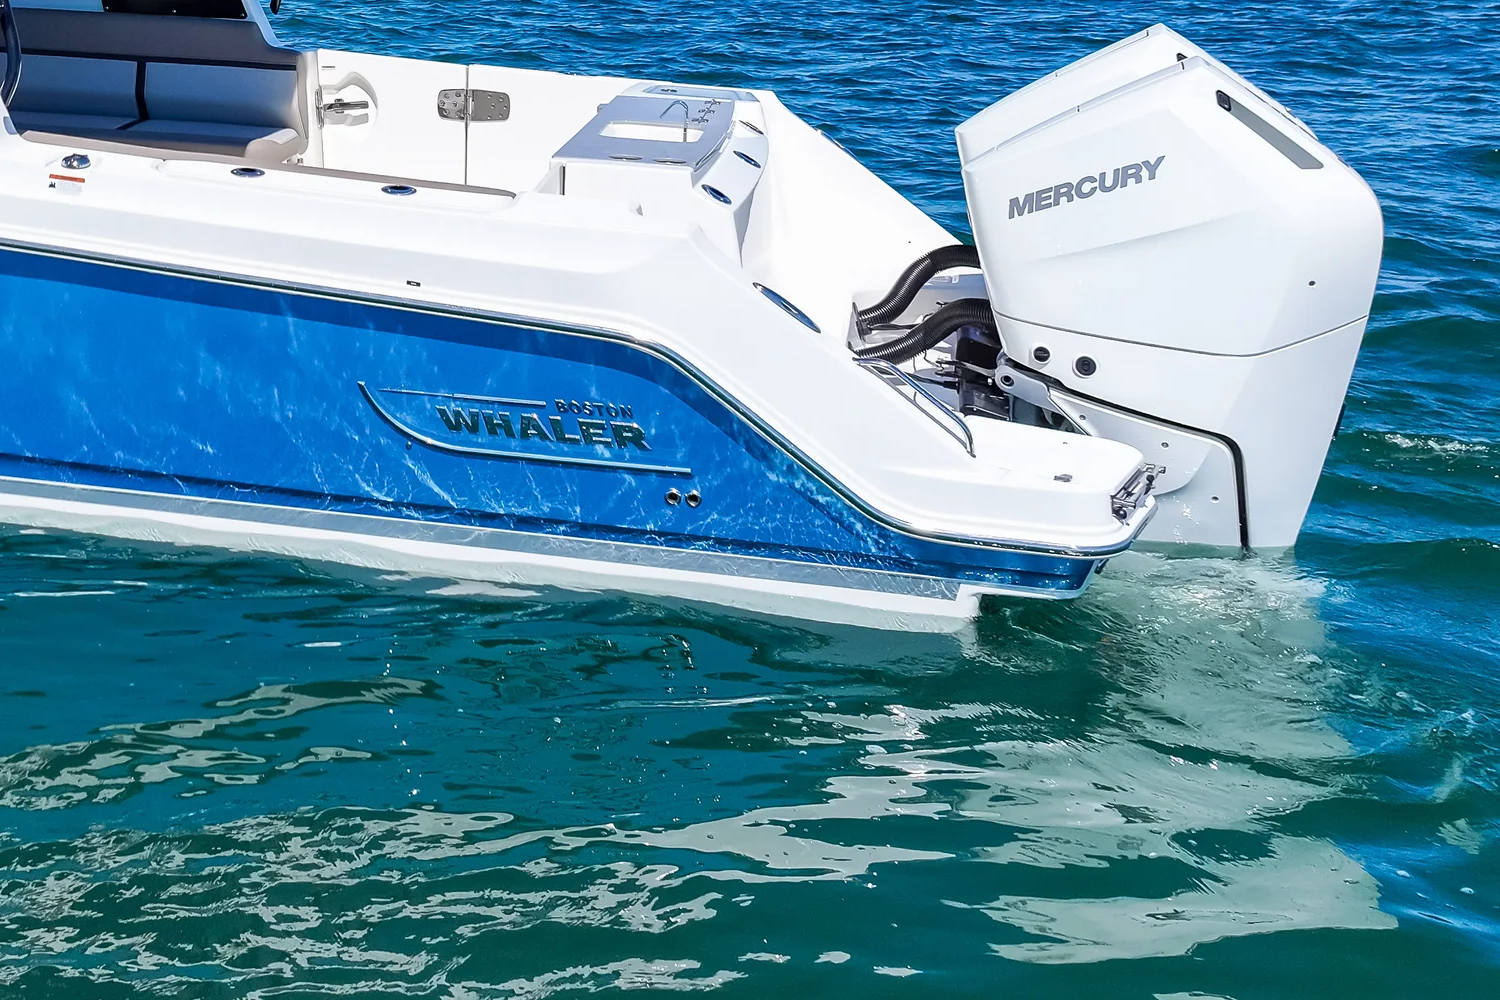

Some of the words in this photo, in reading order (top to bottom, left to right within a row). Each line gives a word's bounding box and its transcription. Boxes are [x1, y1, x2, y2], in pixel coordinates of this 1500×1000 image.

[1008, 155, 1166, 220] MERCURY
[435, 405, 652, 451] WHALER
[555, 399, 633, 419] BOSTON
